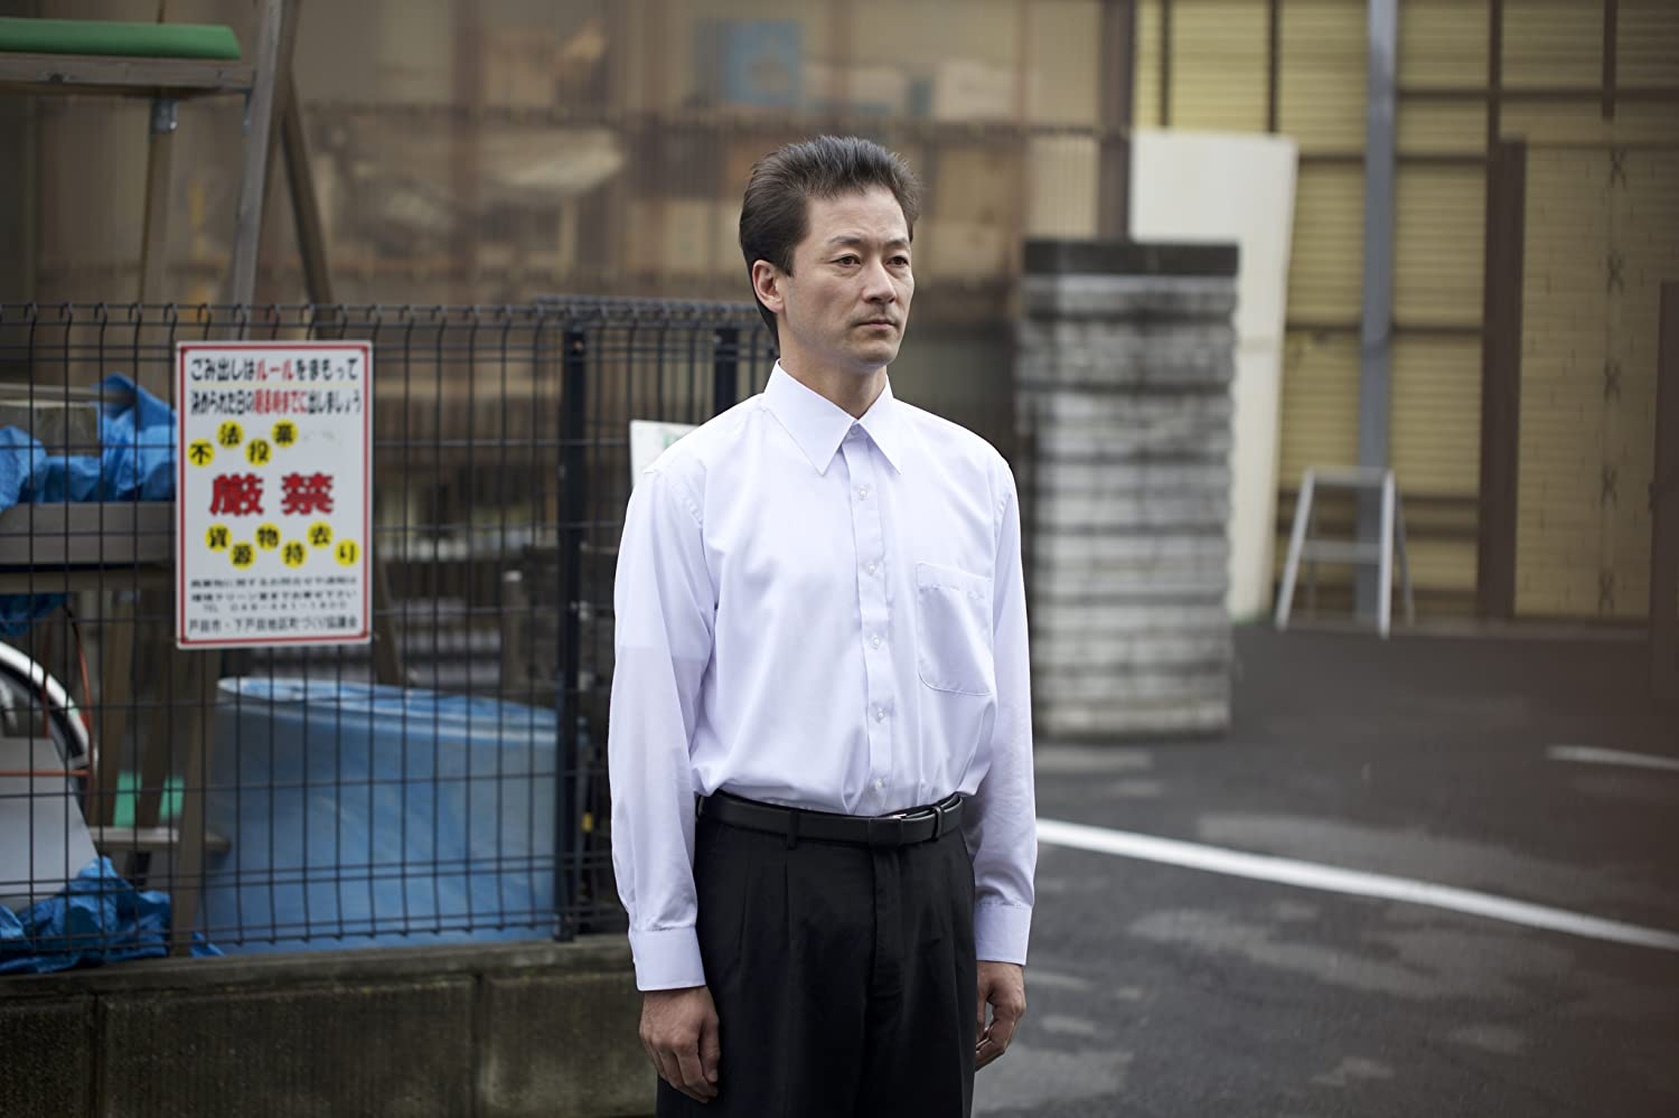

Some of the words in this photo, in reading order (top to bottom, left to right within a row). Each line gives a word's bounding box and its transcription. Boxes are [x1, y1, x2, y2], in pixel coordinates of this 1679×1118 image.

[191, 357, 358, 381] ごみ出しはルールをまもって
[209, 472, 334, 517] 厳禁
